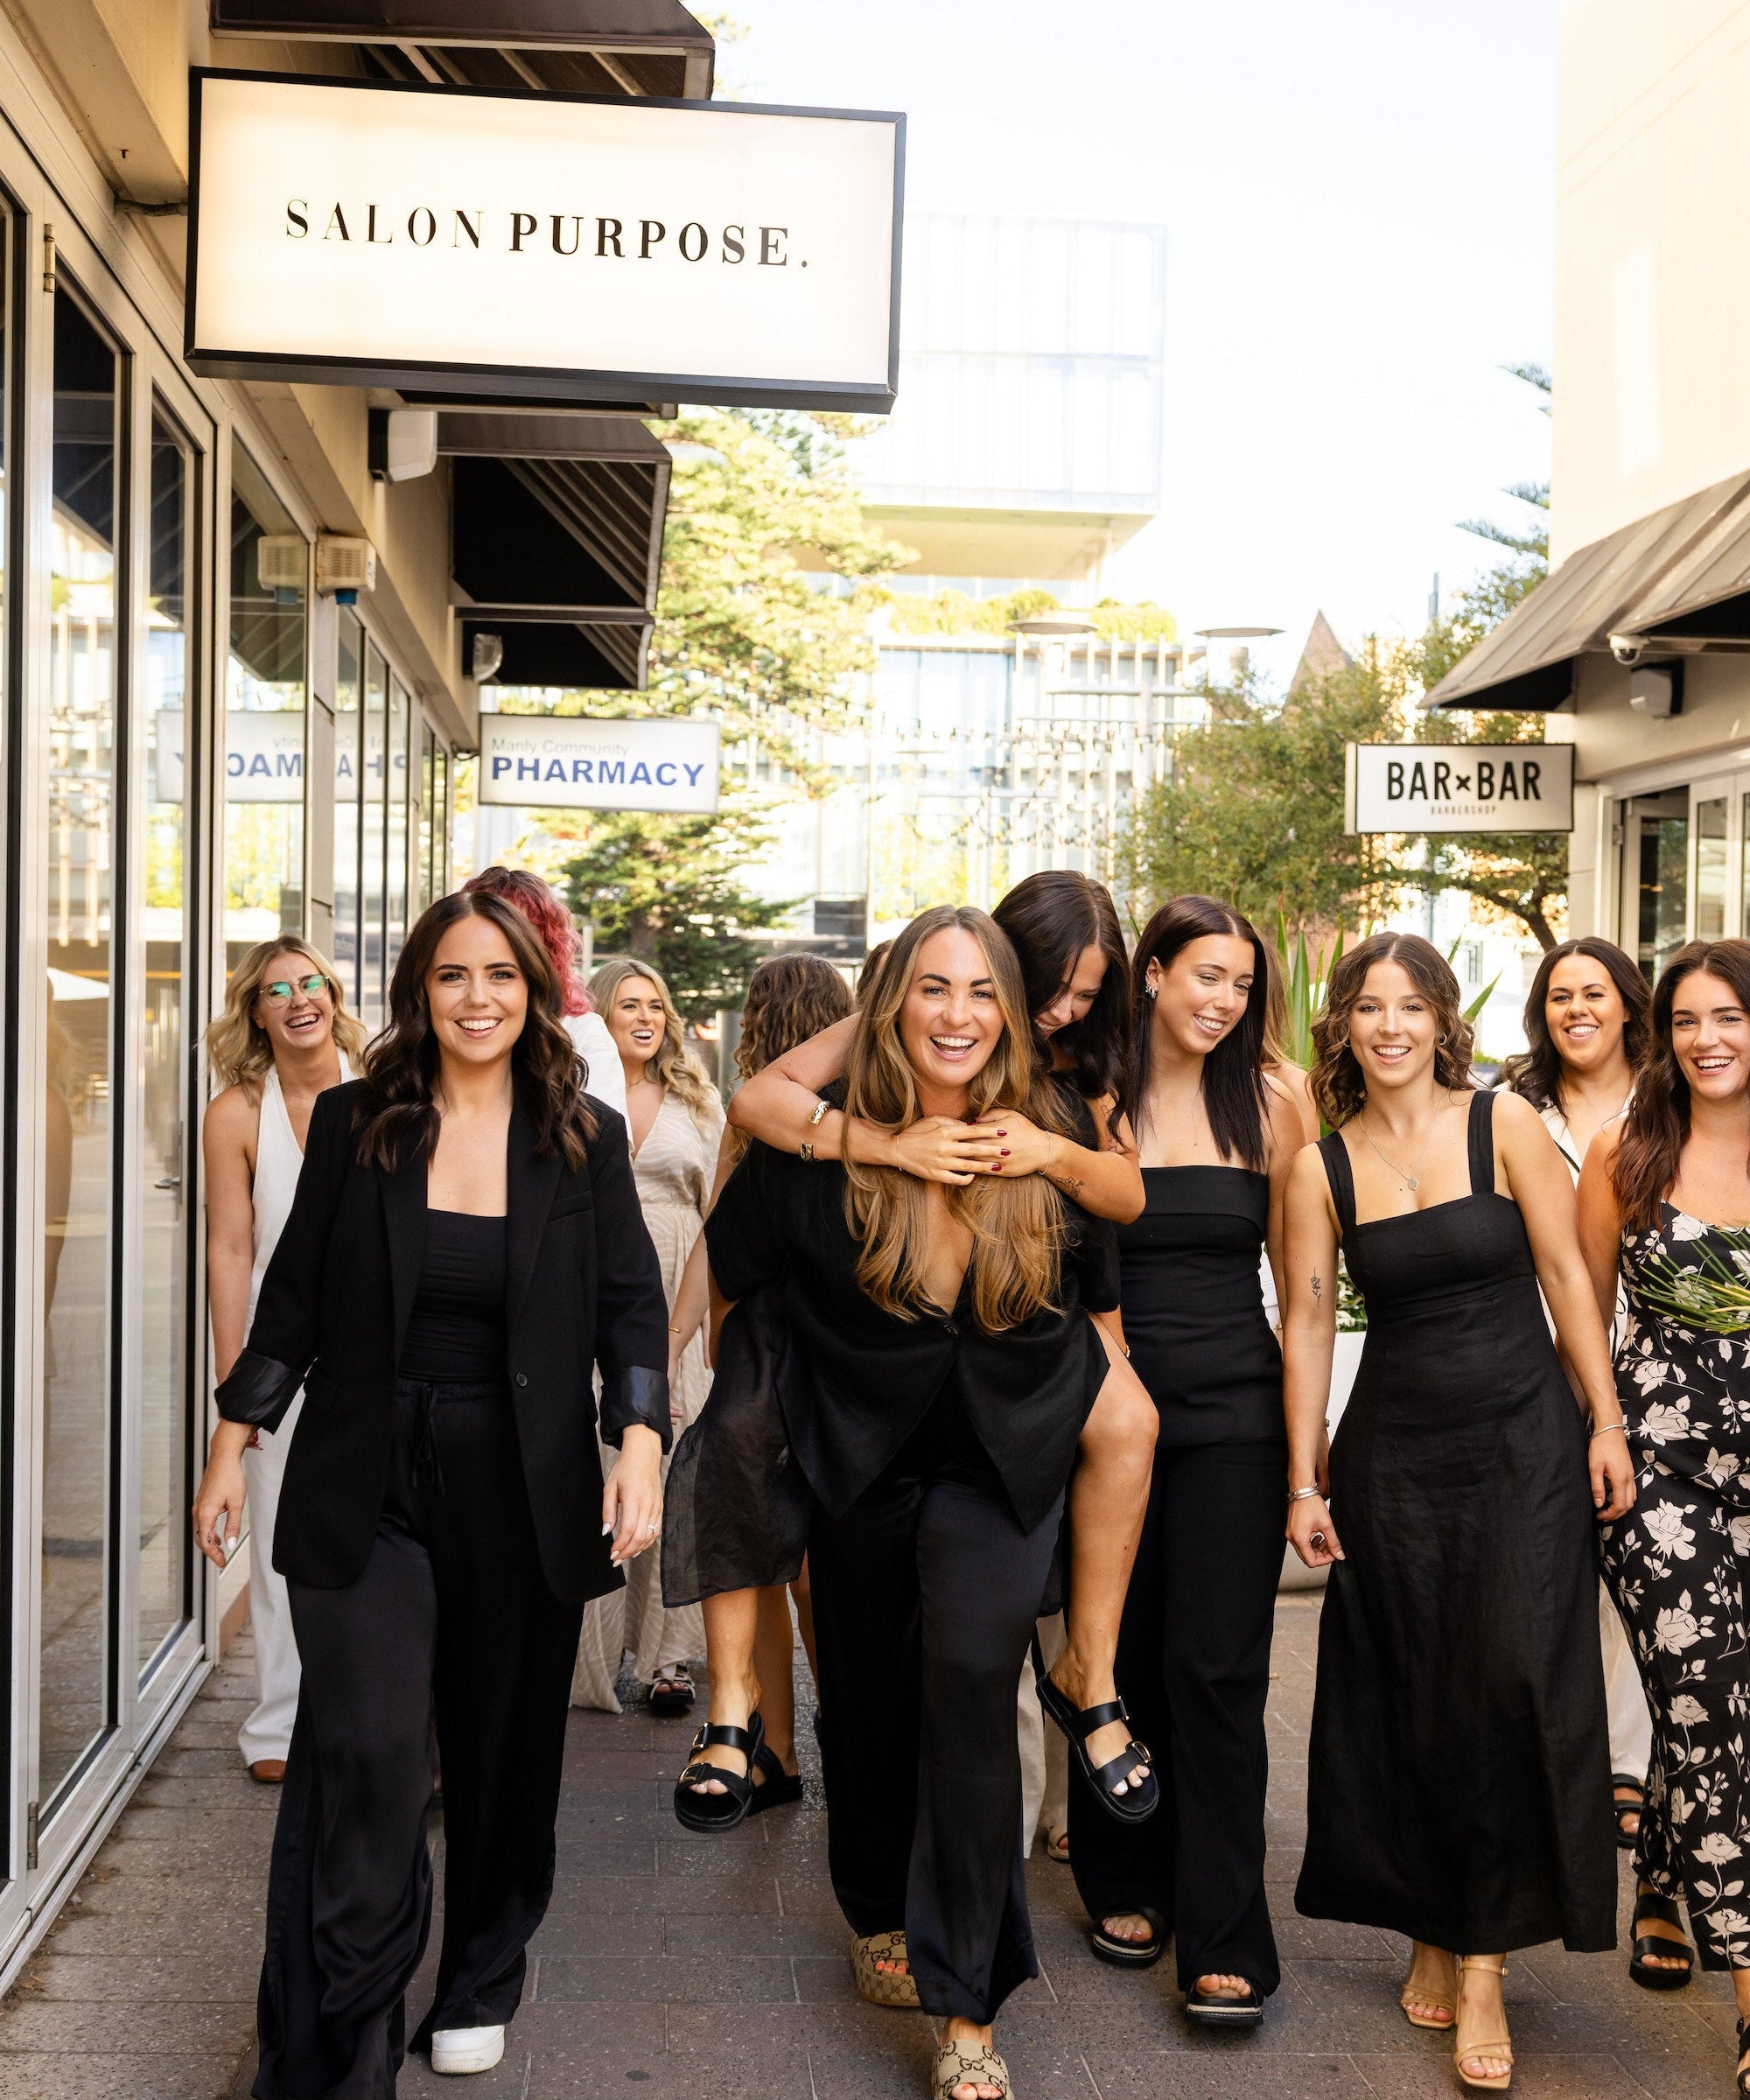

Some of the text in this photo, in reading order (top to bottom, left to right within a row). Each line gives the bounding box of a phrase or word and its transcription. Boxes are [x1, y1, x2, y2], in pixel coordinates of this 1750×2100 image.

[285, 199, 809, 268] SALON PURPOSE.
[491, 738, 629, 756] Manly Community
[492, 757, 704, 787] PHARMACY
